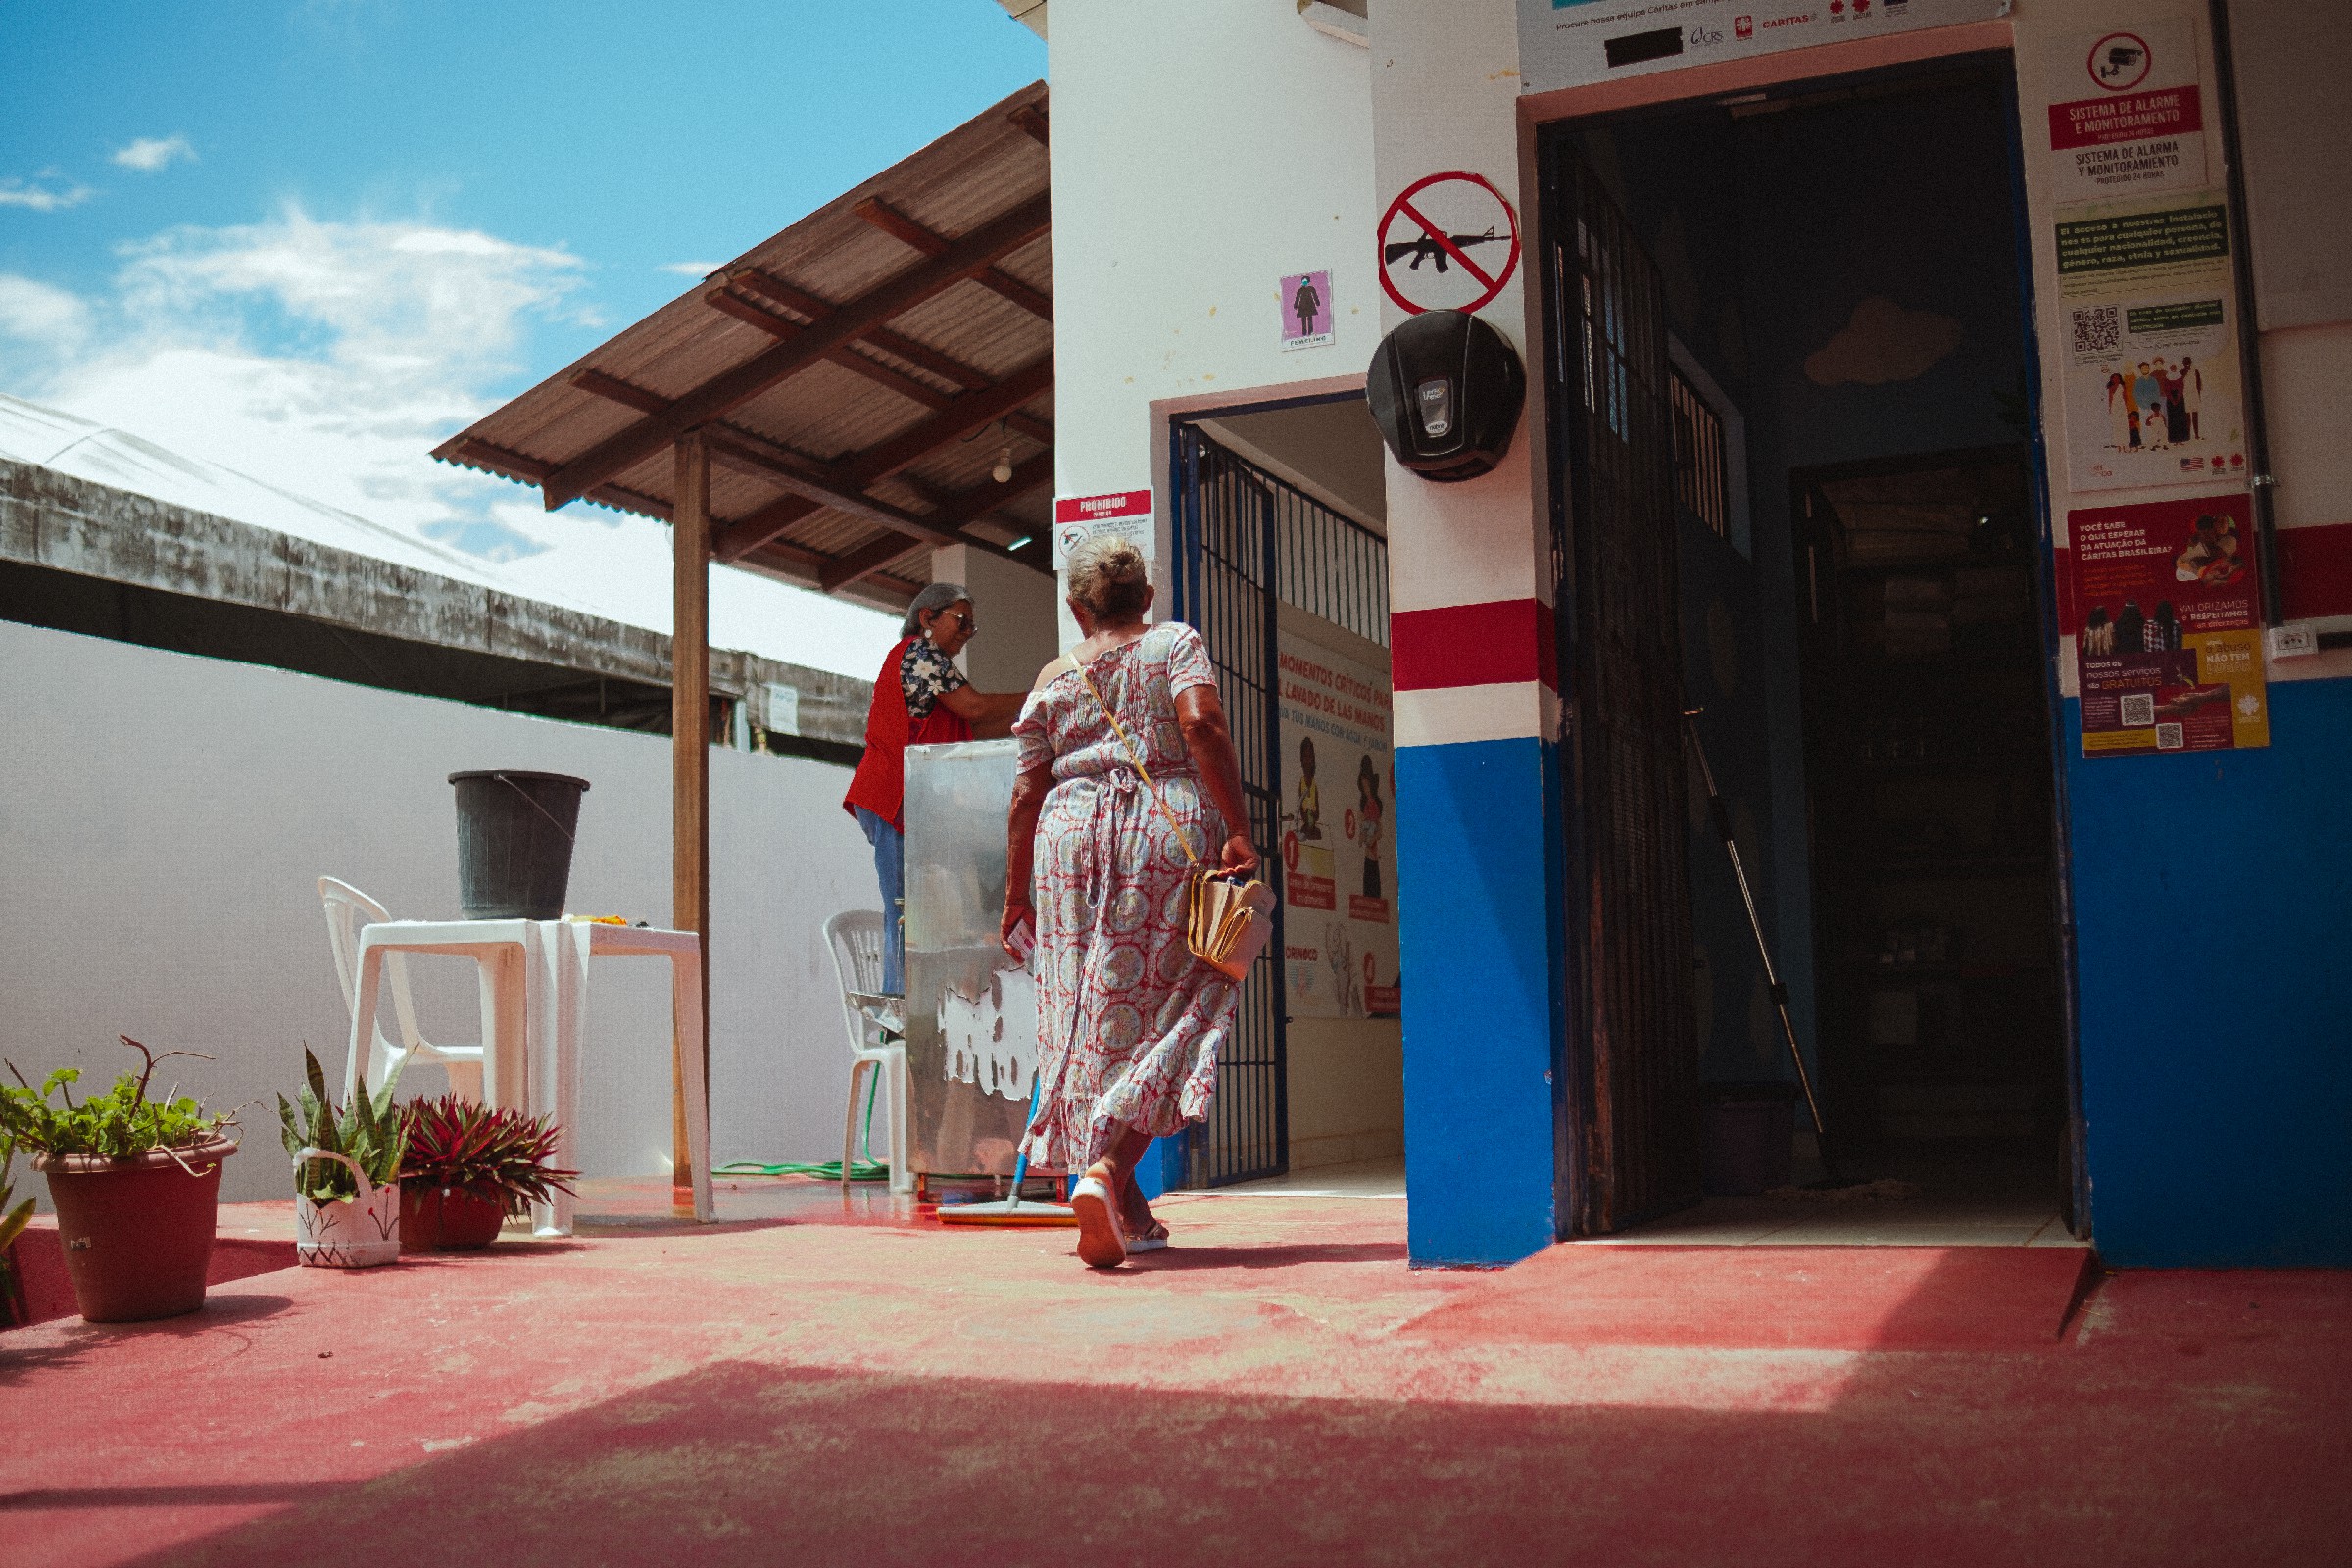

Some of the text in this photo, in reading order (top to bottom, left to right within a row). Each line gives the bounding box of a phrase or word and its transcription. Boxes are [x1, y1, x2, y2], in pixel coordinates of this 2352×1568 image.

[1556, 20, 1589, 31] Procure
[1591, 15, 1615, 25] nossa
[1617, 10, 1645, 22] equipe
[1763, 15, 1809, 28] CARITAS
[1703, 31, 1724, 43] CRS
[2070, 94, 2180, 121] SISTEMA DE ALARME
[2075, 110, 2180, 135] E MONITORAMENTO
[2076, 141, 2180, 166] SISTEMA DE ALARMA
[2078, 154, 2179, 177] Y MONITORAMIENTO
[2096, 175, 2132, 185] PROTEGIDO
[2060, 226, 2070, 236] El
[2074, 223, 2108, 234] acceso
[2123, 217, 2165, 228] nuestras
[2061, 237, 2079, 246] nes
[2093, 234, 2115, 245] para
[2116, 226, 2162, 241] cualquier
[2209, 220, 2222, 229] de
[2062, 245, 2107, 258] cualquier
[2128, 250, 2153, 261] etnia
[1080, 496, 1127, 513] PROHIBIDO
[2079, 520, 2126, 532] VOCÊ SABE
[2108, 529, 2145, 539] ESPERAR
[2093, 538, 2133, 551] ATUAÇÃO
[2081, 546, 2173, 561] CÁRITAS BRASILEIRA?
[2179, 599, 2248, 612] VALORIZAMOS
[2190, 610, 2248, 621] RESPEITAMOS
[2216, 642, 2251, 653] abuso
[2206, 652, 2250, 663] NÃO TEM
[1279, 651, 1332, 688] MOMENTOS
[2086, 667, 2162, 679] nossos serviços
[2101, 676, 2162, 690] GRATUITOS
[1285, 681, 1321, 710] LAVADO
[1323, 695, 1335, 714] DE
[1337, 700, 1353, 721] LAS
[1354, 708, 1386, 733] MANOS
[1292, 709, 1304, 725] TUS
[1304, 714, 1330, 735] MANOS
[1348, 813, 1354, 836] 2
[1289, 840, 1294, 865] 1
